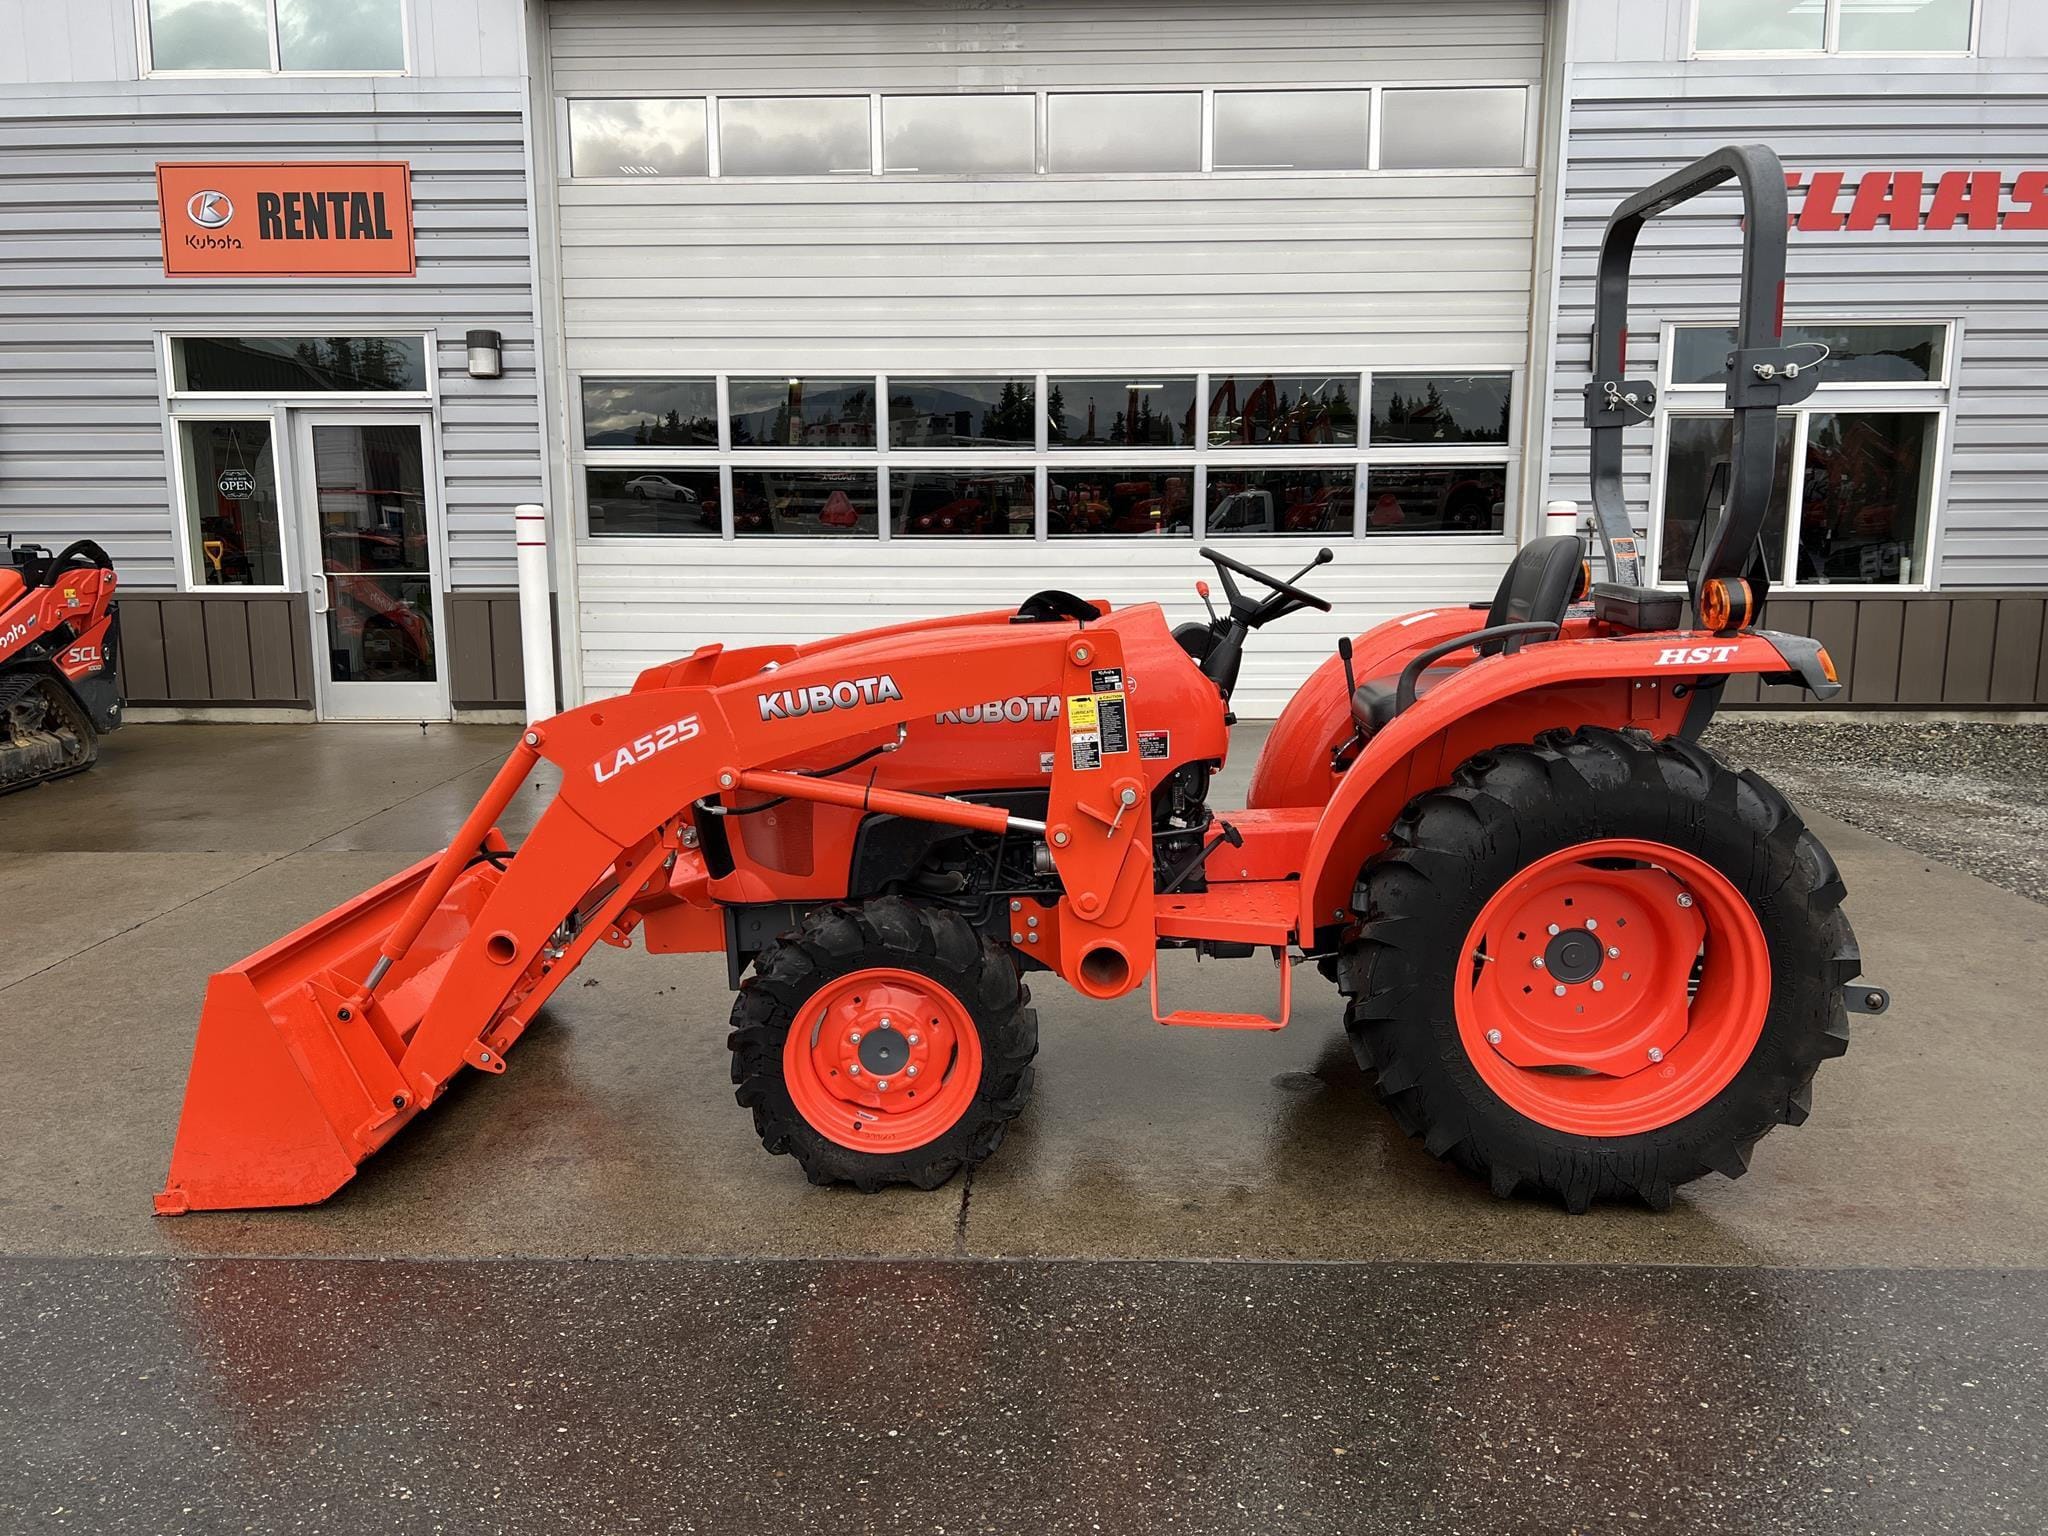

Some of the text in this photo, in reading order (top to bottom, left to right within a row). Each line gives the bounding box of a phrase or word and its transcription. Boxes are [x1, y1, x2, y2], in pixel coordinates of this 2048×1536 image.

[257, 192, 393, 240] RENTAL
[1741, 171, 2048, 231] LAAS
[185, 235, 243, 250] Kubota
[220, 481, 253, 491] OPEN
[69, 646, 101, 663] SCL
[1653, 646, 1739, 666] HST
[757, 675, 904, 722] KUBOTA
[593, 715, 699, 783] LA525
